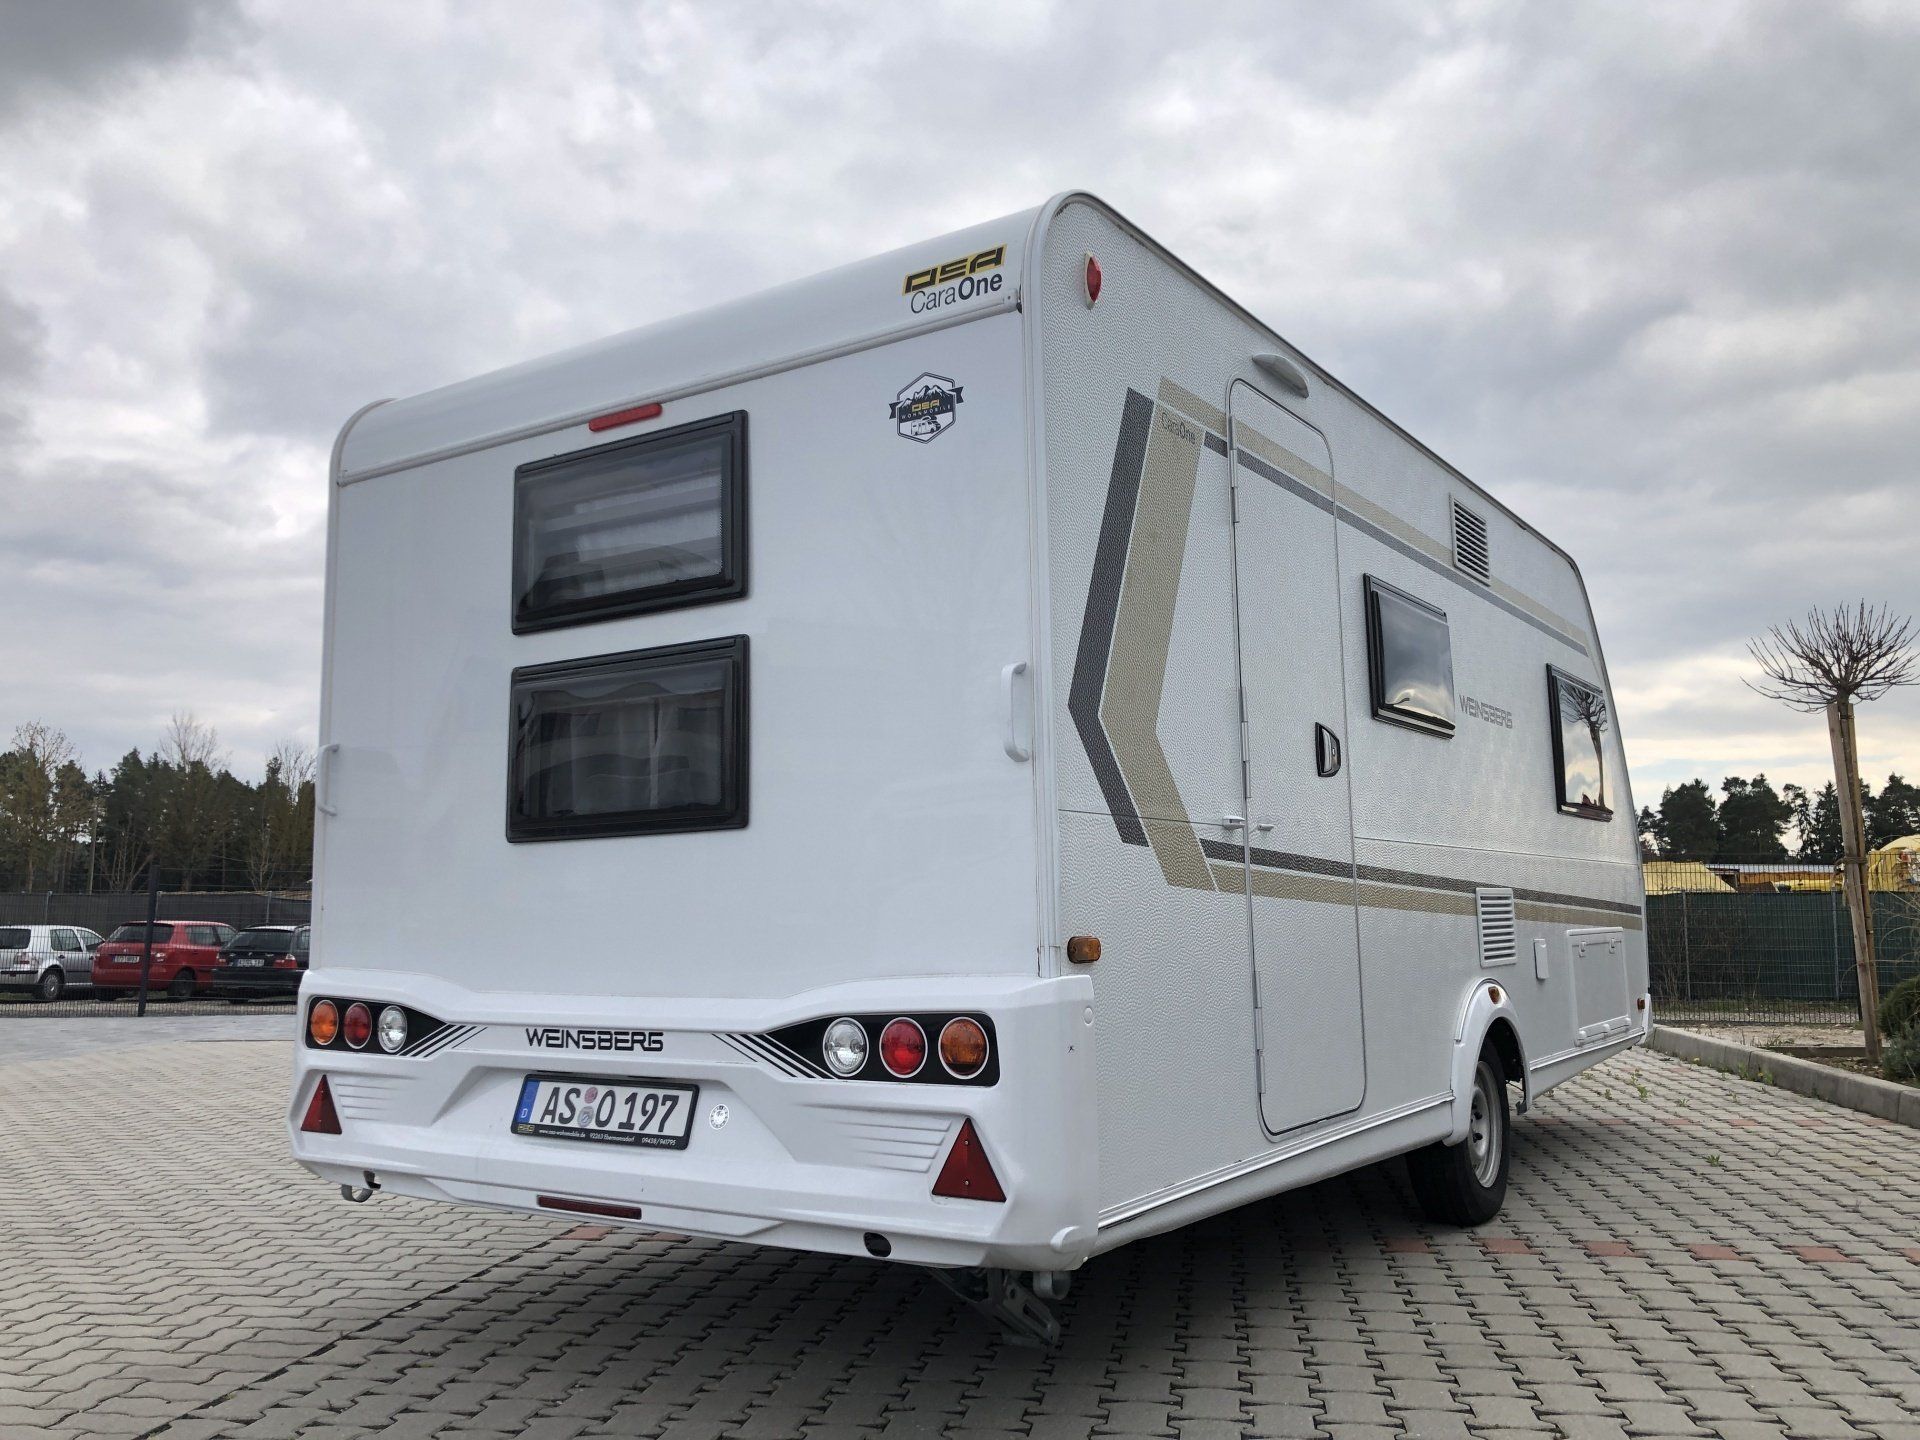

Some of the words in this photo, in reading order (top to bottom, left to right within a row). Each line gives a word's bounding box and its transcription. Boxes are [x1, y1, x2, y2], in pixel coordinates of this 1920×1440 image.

[910, 273, 1003, 314] CaraOne
[1459, 694, 1513, 729] WEINSBERG
[525, 1028, 664, 1051] WEINSBERG
[521, 1110, 528, 1119] D
[540, 1086, 581, 1125] AS
[618, 1092, 680, 1133] 197
